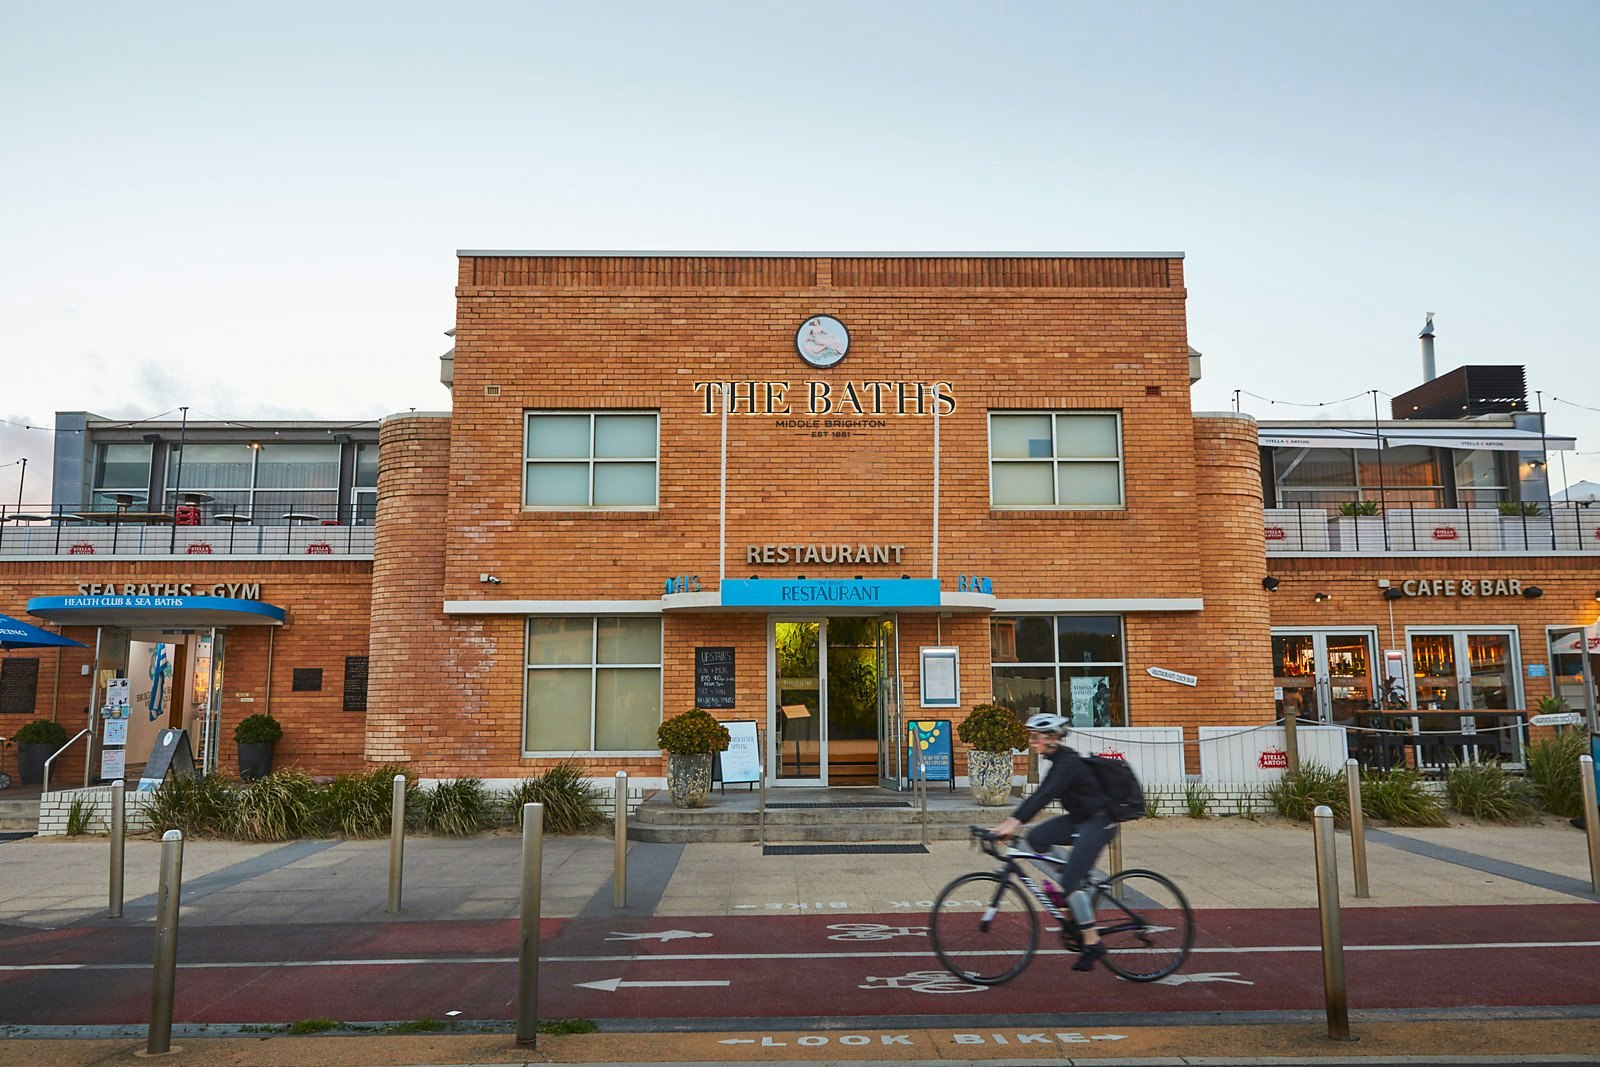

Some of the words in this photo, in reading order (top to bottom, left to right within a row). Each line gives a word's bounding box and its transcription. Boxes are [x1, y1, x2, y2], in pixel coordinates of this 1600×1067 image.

[694, 380, 791, 414] THE
[804, 380, 956, 416] BATHS
[775, 420, 820, 428] MIDDLE
[824, 420, 886, 428] BRIGHTON
[747, 544, 905, 564] RESTAURANT
[77, 583, 117, 596] SEA
[123, 583, 192, 597] BATHS
[211, 584, 260, 600] GYM
[781, 585, 881, 602] RESTAURANT
[1403, 579, 1456, 596] CAFE
[1461, 579, 1476, 596] &
[1480, 579, 1522, 596] BAR
[64, 598, 99, 606] HEALTH
[101, 598, 123, 606] CLUB
[125, 598, 132, 606] &
[135, 598, 151, 606] SEA
[154, 598, 183, 606] BATHS
[701, 651, 732, 662] UPSTAIRS
[761, 1034, 915, 1047] LOOK
[952, 1032, 1091, 1045] BIKE
